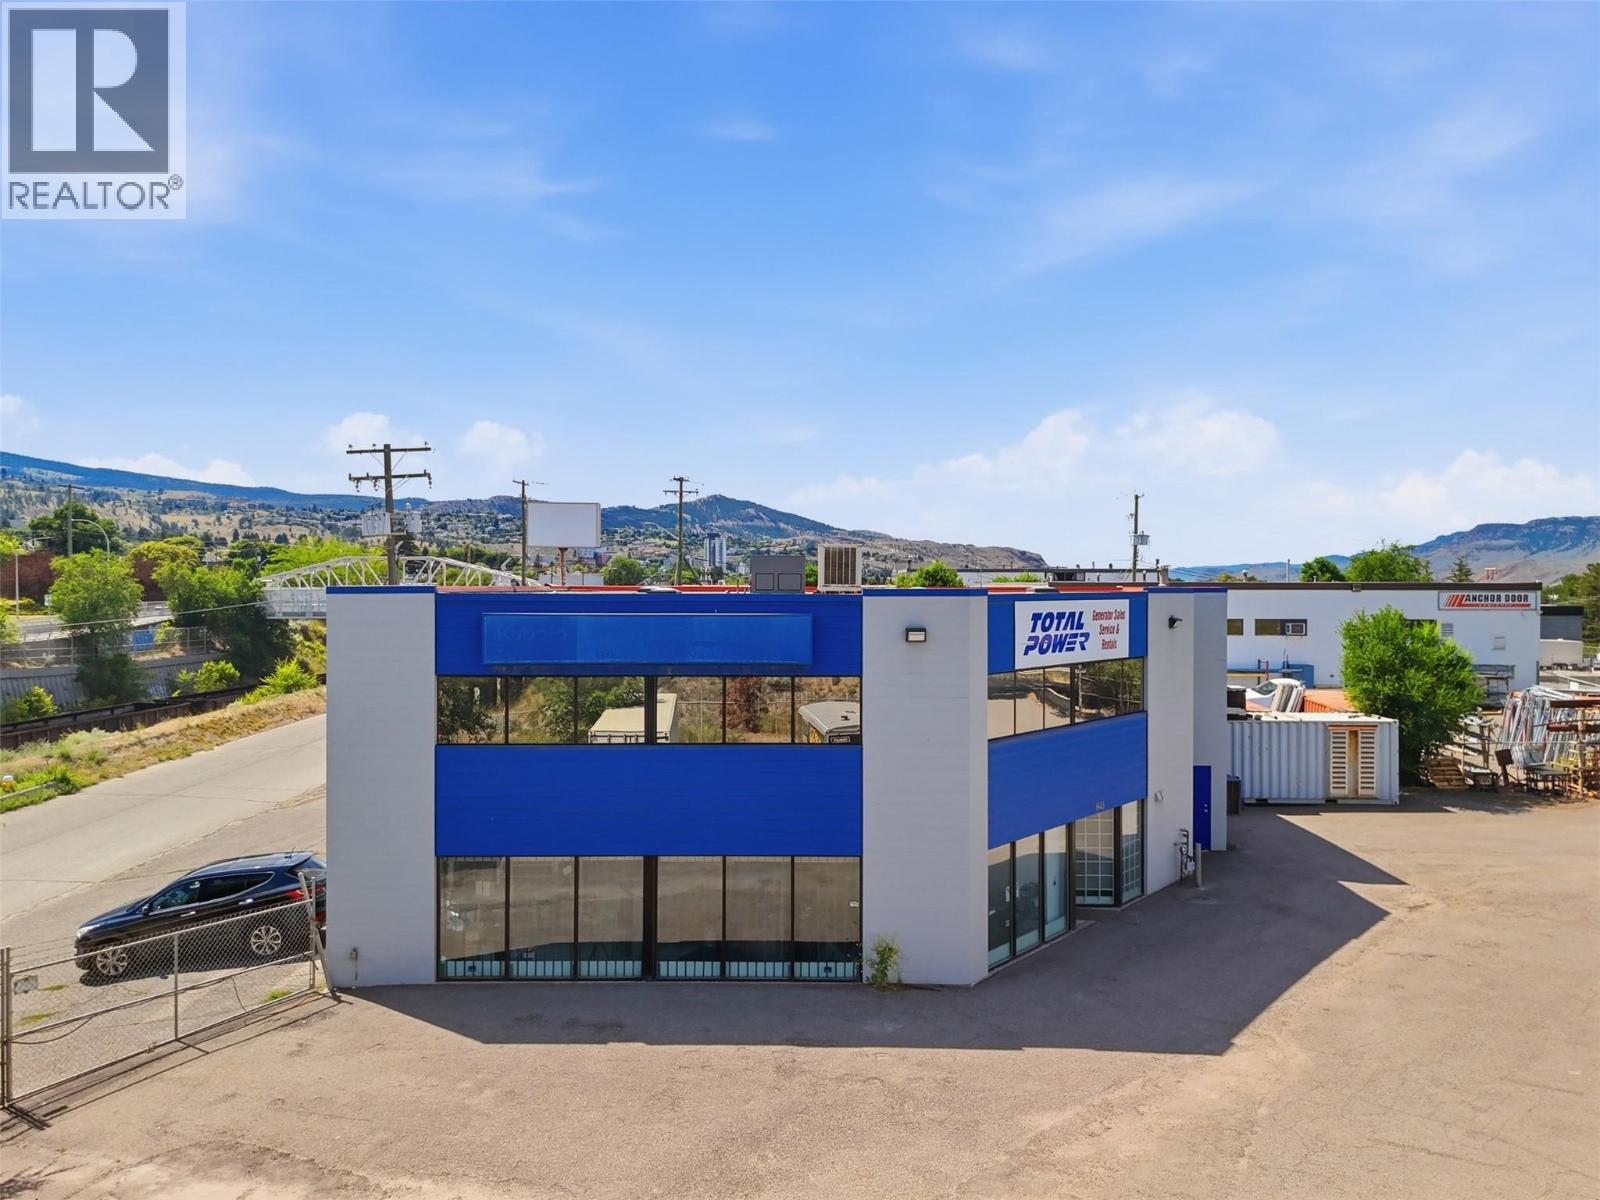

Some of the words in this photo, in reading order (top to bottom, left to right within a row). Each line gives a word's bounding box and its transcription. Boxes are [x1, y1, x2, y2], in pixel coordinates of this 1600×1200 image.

[1465, 594, 1502, 603] ANCHOR
[1504, 594, 1529, 603] DOOR
[1092, 610, 1113, 621] Generator
[1113, 609, 1126, 620] Sales
[1030, 611, 1085, 633] TOTAL
[1099, 624, 1116, 635] Service
[1023, 632, 1091, 656] POWER
[1101, 638, 1118, 650] Rentals
